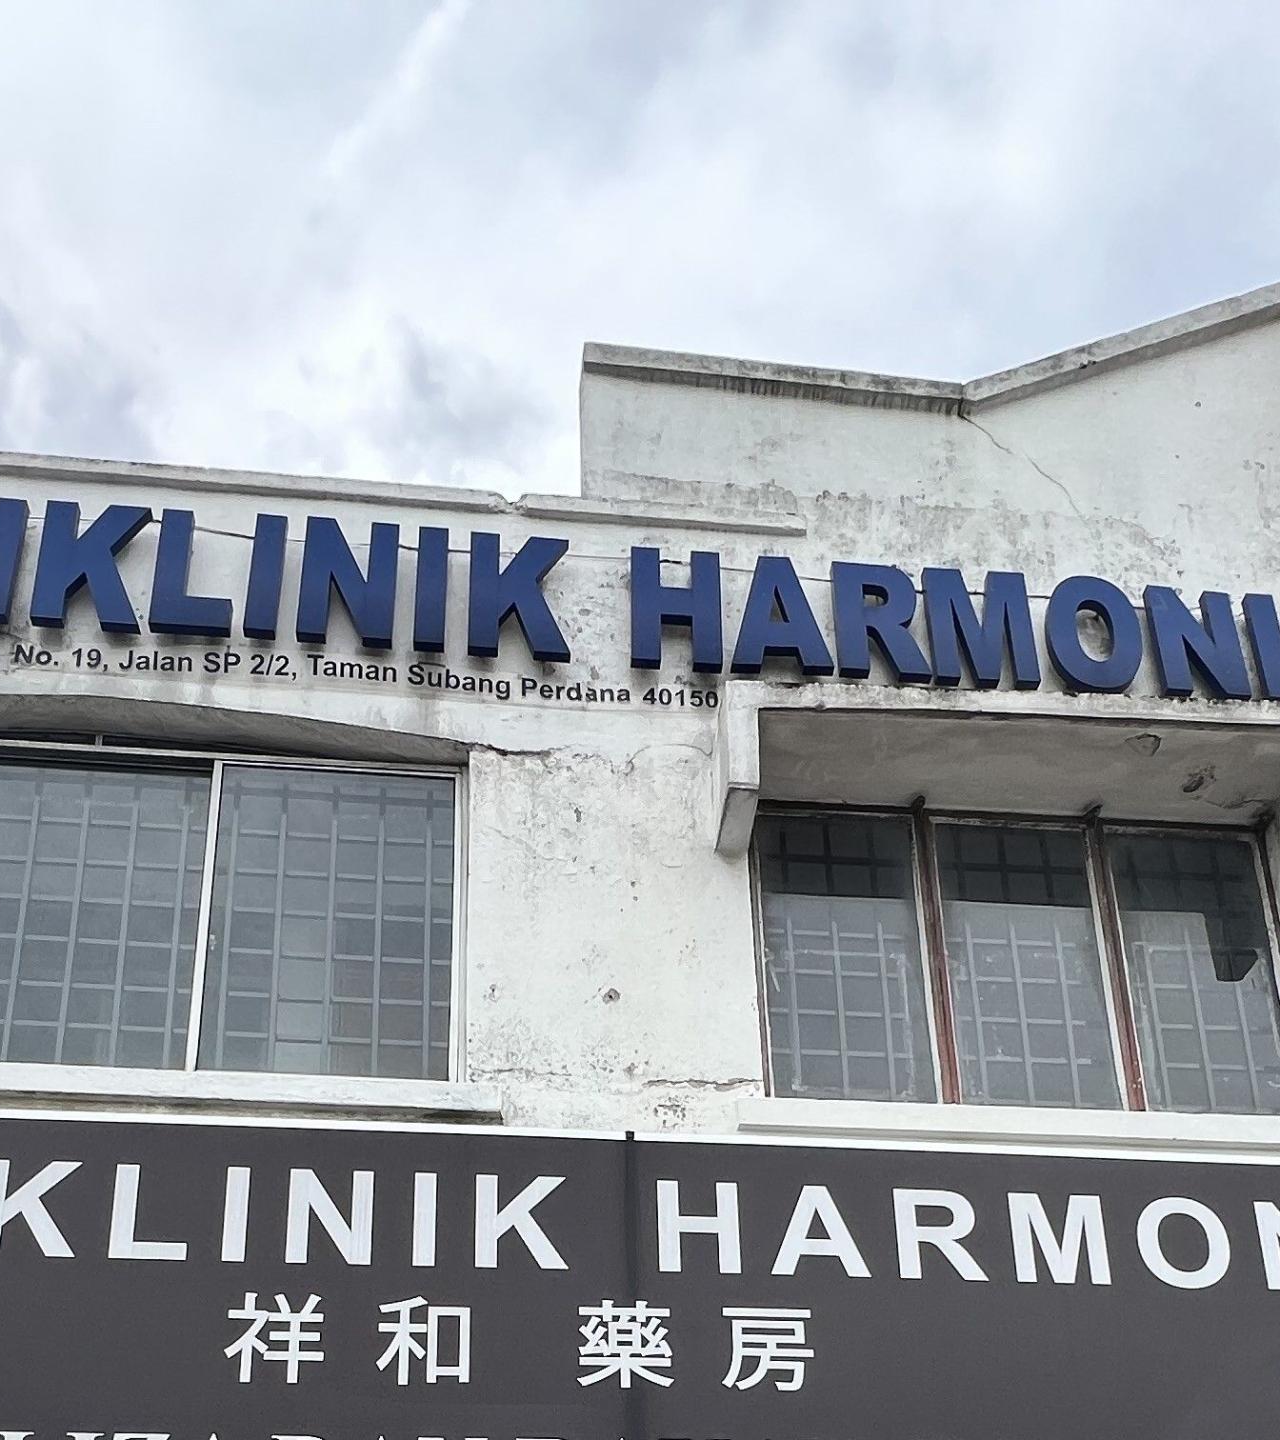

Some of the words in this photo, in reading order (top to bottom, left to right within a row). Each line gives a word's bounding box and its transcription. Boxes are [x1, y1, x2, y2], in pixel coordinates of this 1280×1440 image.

[12, 643, 61, 668] No.
[72, 646, 109, 674] 19,
[119, 649, 195, 674] Jalan
[203, 649, 241, 676] SP
[250, 652, 298, 682] 2/2,
[307, 655, 398, 684] Taman
[408, 662, 512, 702] Subang
[520, 677, 632, 706] Perdana
[642, 686, 720, 710] 40150
